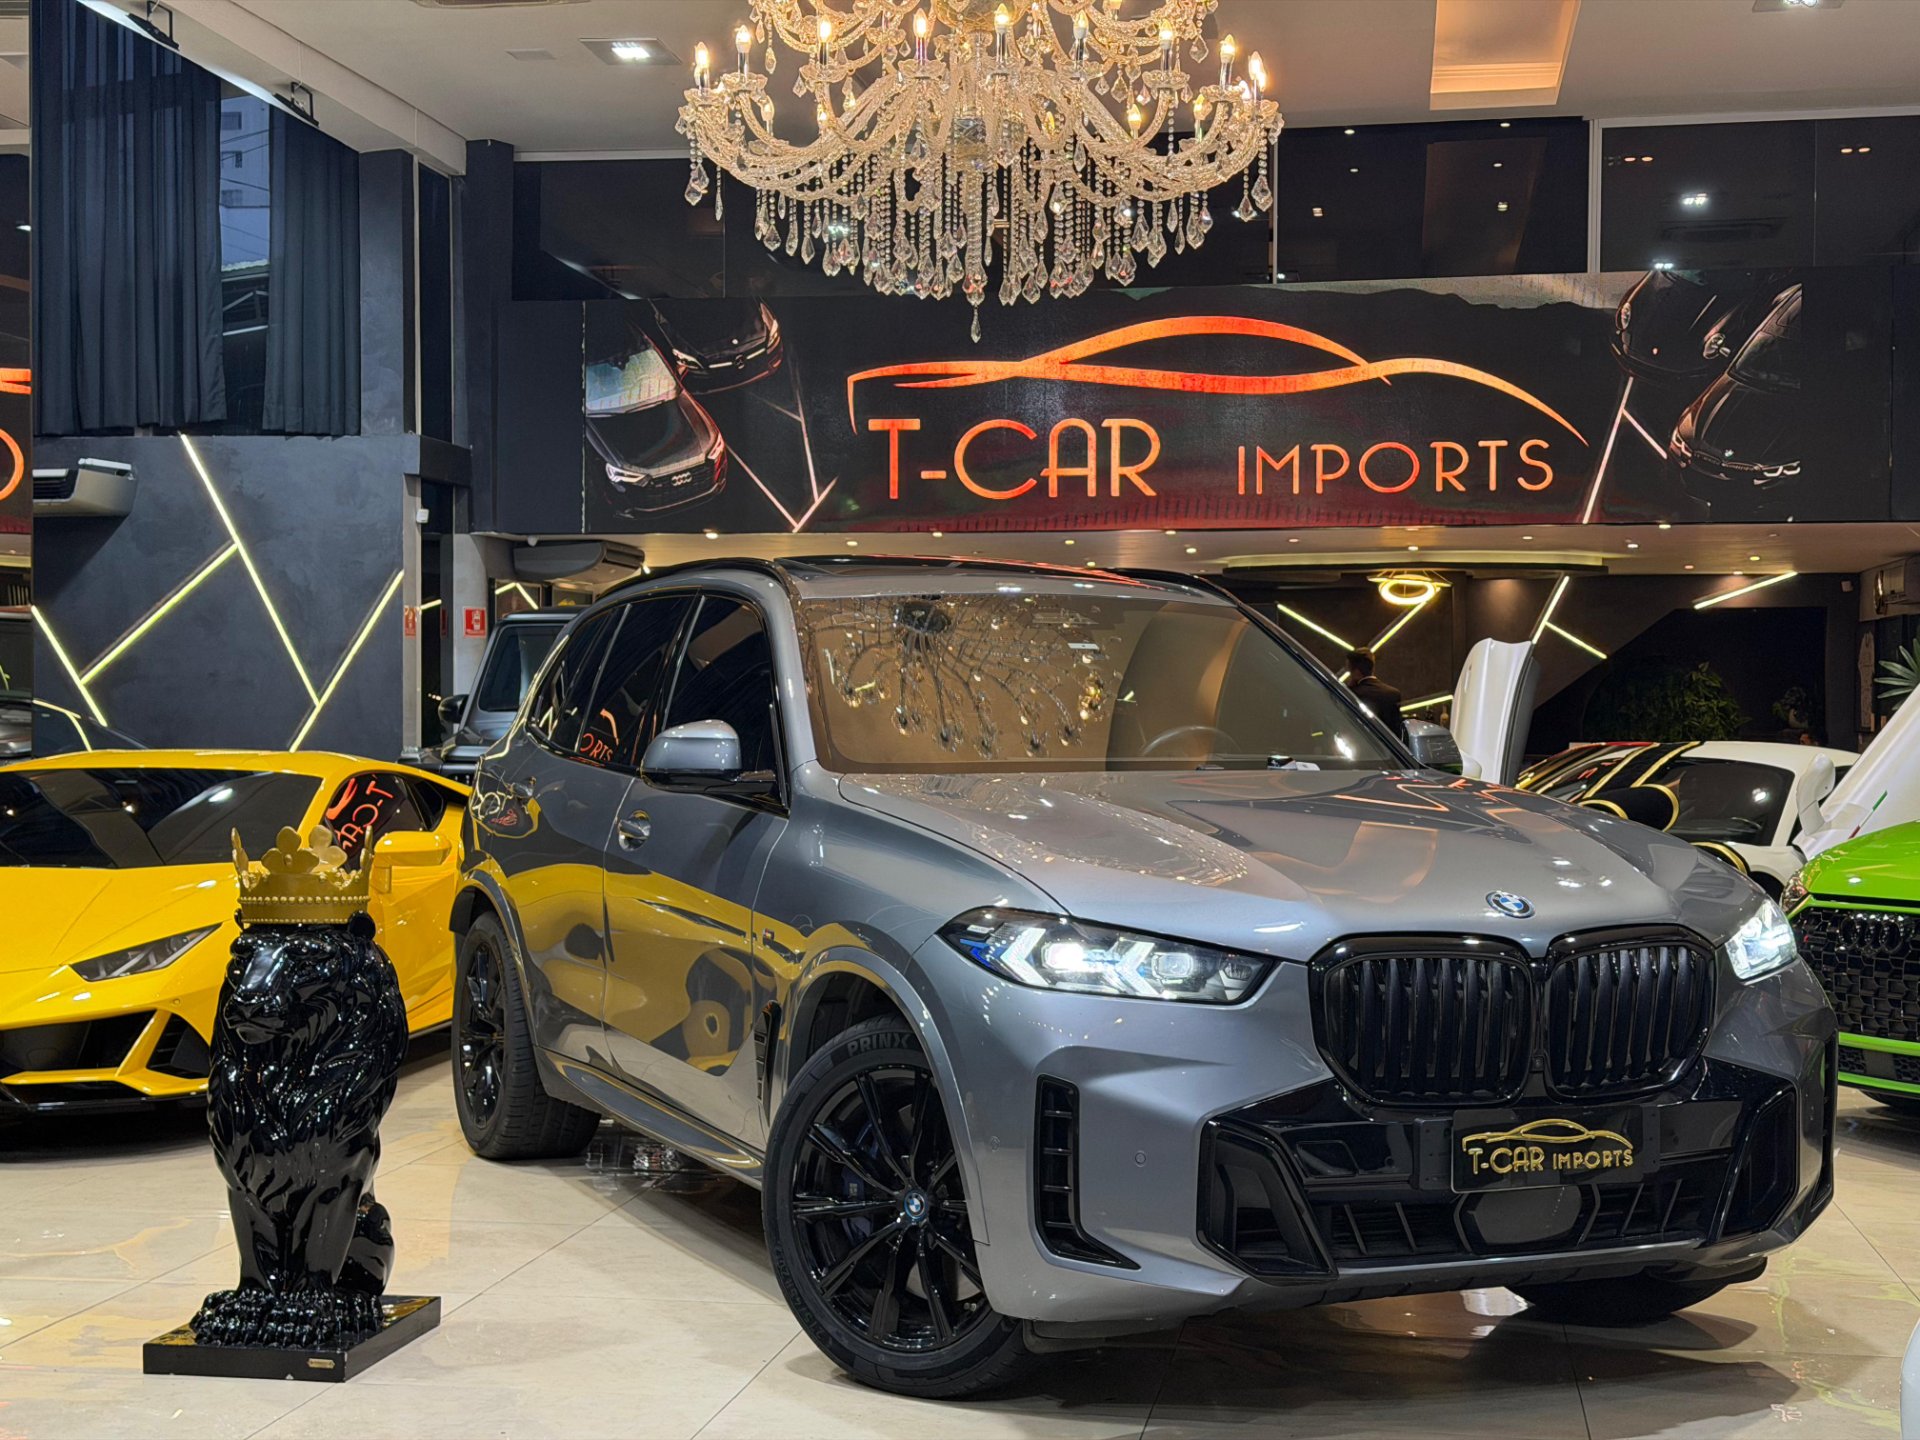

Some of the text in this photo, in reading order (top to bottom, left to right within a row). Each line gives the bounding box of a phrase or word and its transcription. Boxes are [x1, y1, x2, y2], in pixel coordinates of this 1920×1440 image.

[867, 417, 1555, 500] T-CAR IMPORTS
[847, 1032, 911, 1057] PRINX
[1468, 1146, 1634, 1175] T-CAR IMPORTS
